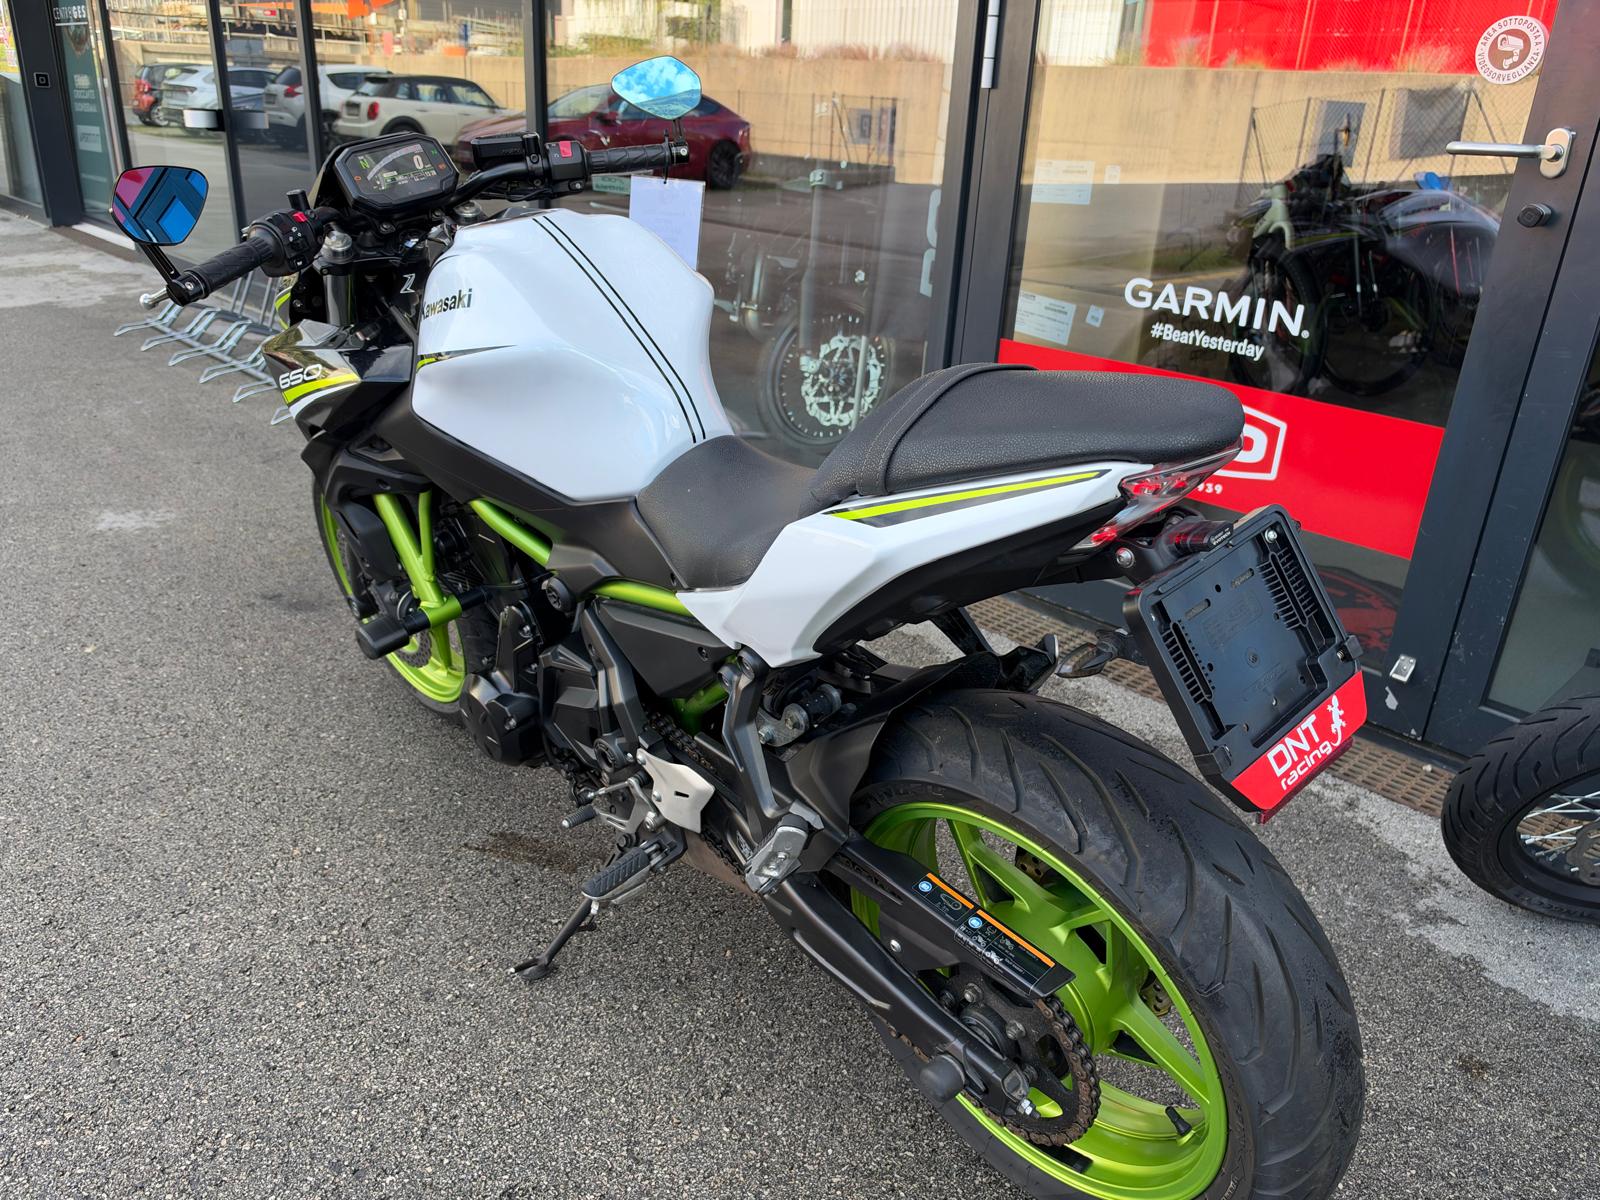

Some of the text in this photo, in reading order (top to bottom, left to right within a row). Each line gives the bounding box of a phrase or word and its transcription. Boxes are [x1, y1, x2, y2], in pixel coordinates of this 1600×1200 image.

[1481, 27, 1498, 47] AREA
[1497, 17, 1542, 40] SOTTOPOSTA
[423, 288, 473, 320] awasaki
[1150, 321, 1265, 361] #BeatYesterday
[279, 363, 323, 389] 650
[1266, 714, 1320, 778] DNT
[1281, 741, 1333, 791] racing
